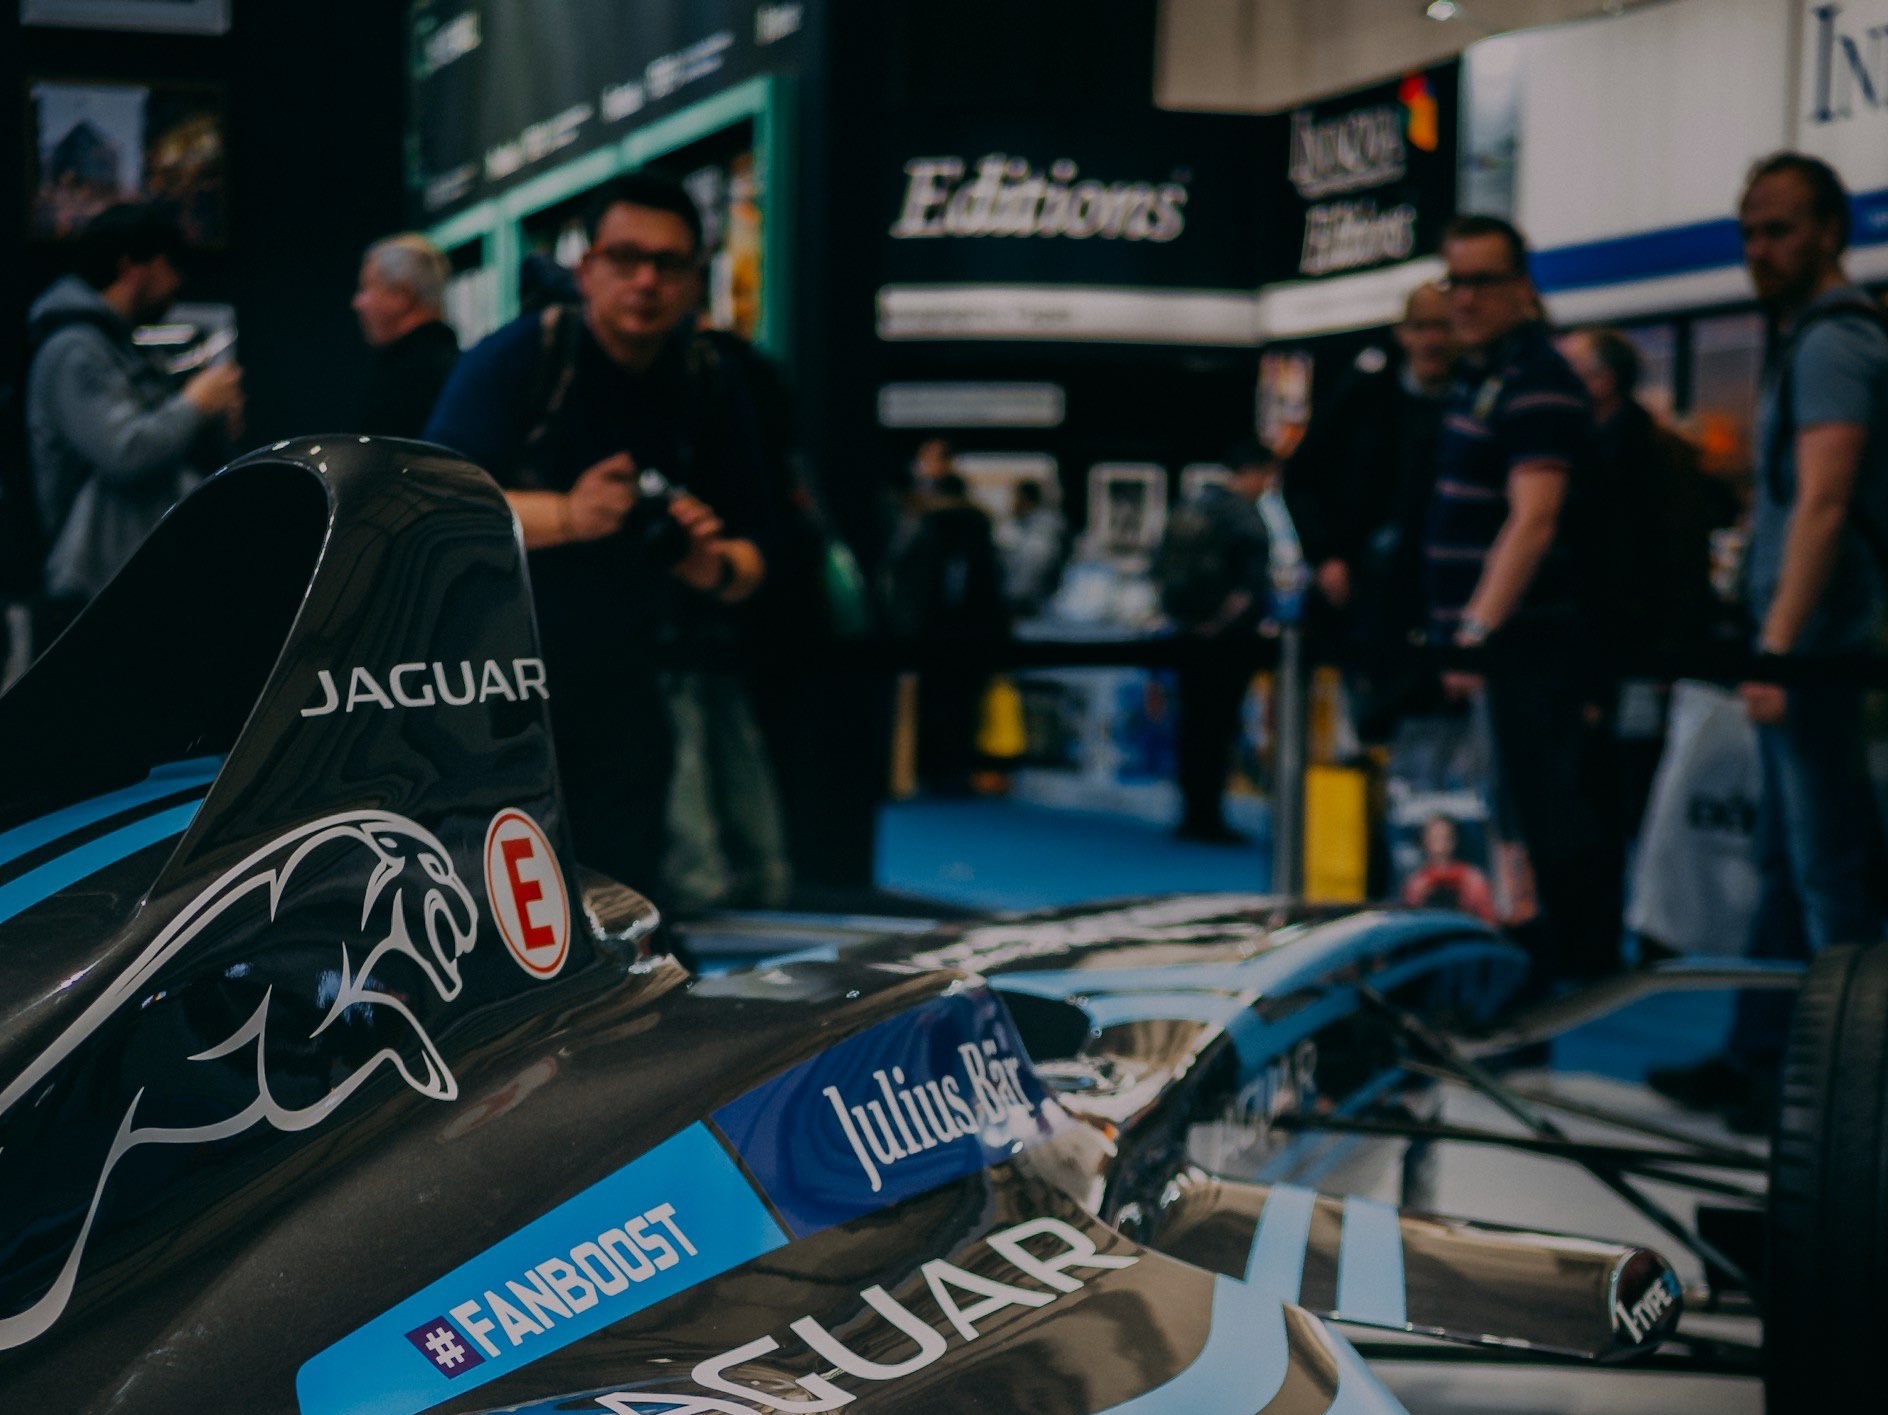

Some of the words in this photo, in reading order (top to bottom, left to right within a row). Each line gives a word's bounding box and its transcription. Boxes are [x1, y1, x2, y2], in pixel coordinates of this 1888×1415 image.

[888, 152, 1188, 243] Editions
[300, 657, 550, 717] JAGUAR
[501, 837, 555, 950] E
[822, 1065, 979, 1192] Julius
[957, 1038, 1035, 1125] Bär
[424, 1202, 699, 1369] #FANBOOST
